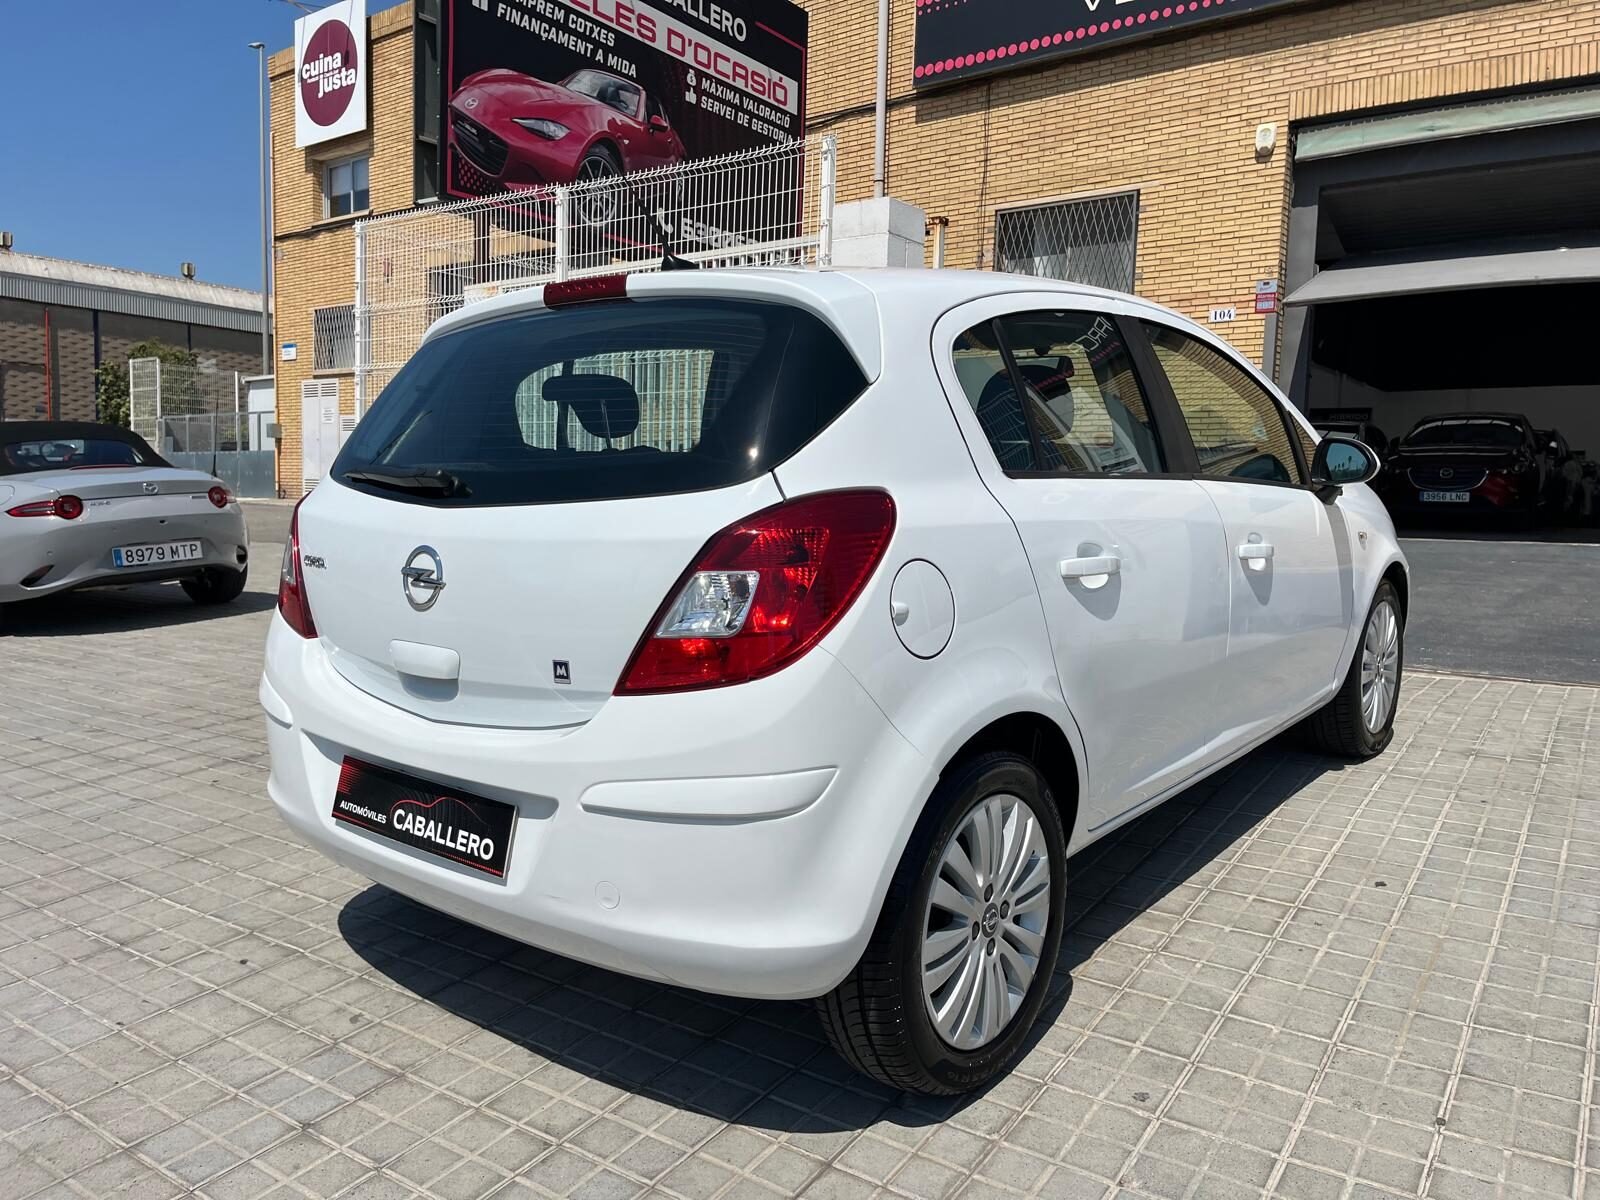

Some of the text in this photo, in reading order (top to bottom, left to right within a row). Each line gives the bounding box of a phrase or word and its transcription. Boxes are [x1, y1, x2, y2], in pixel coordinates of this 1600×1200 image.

[496, 4, 637, 78] FINANÇAMENT A MIDA
[568, 13, 615, 47] COTXES
[301, 52, 342, 79] cuina
[666, 27, 788, 107] D'OCASIÓ
[317, 67, 356, 98] justa
[700, 96, 735, 121] SERVEI
[737, 111, 750, 127] DE
[701, 77, 791, 128] MÀXIMA VALORACIÓ
[1213, 310, 1232, 321] 104
[125, 543, 198, 563] 8979 MTP
[339, 800, 495, 861] AUTOMÓVILES CABALLERO
